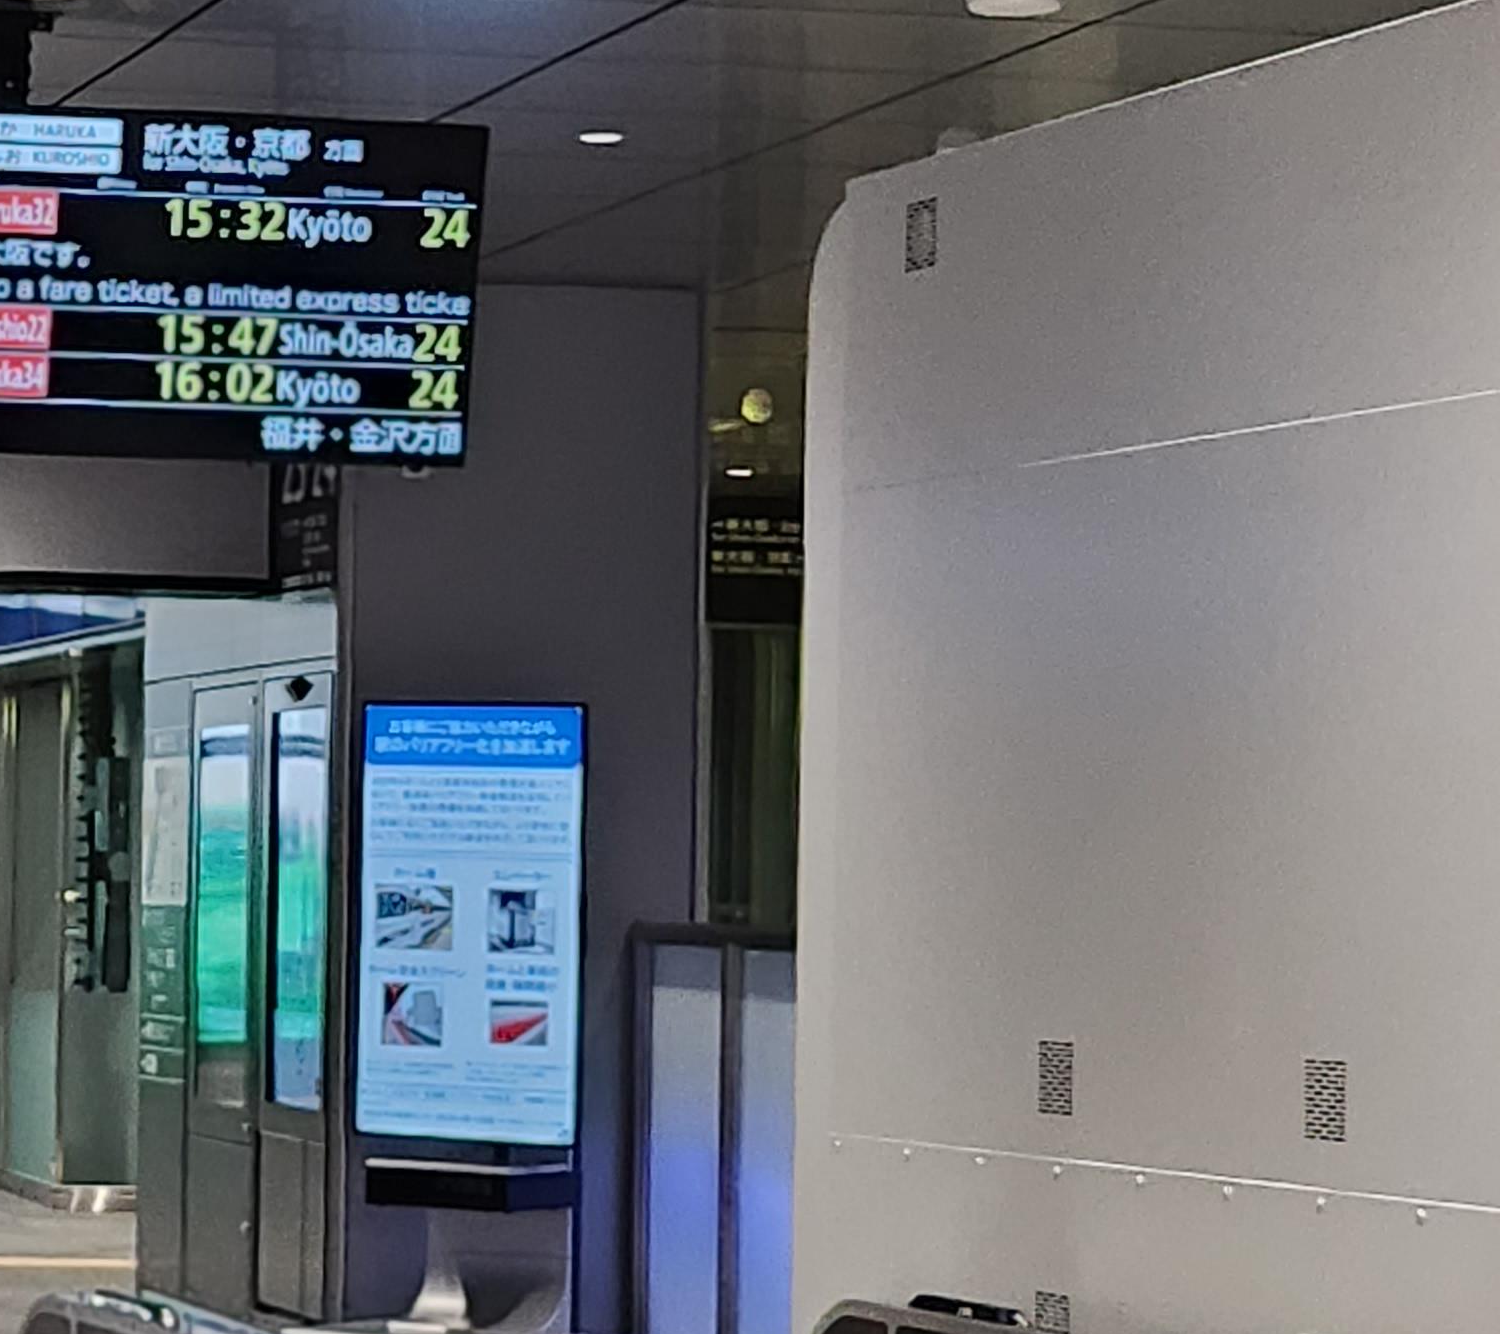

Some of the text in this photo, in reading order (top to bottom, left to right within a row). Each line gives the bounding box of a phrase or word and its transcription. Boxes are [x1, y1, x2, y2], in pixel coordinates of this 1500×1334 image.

[34, 124, 97, 139] HARUKA
[165, 198, 285, 242] 15:32
[420, 207, 471, 248] 24
[16, 278, 35, 300] a
[39, 274, 94, 302] fare
[184, 286, 203, 306] a
[208, 283, 292, 310] limited
[296, 289, 400, 315] express
[157, 314, 278, 356] 15:47
[413, 324, 461, 363] 24
[155, 361, 274, 402] 16:02
[409, 370, 459, 410] 24
